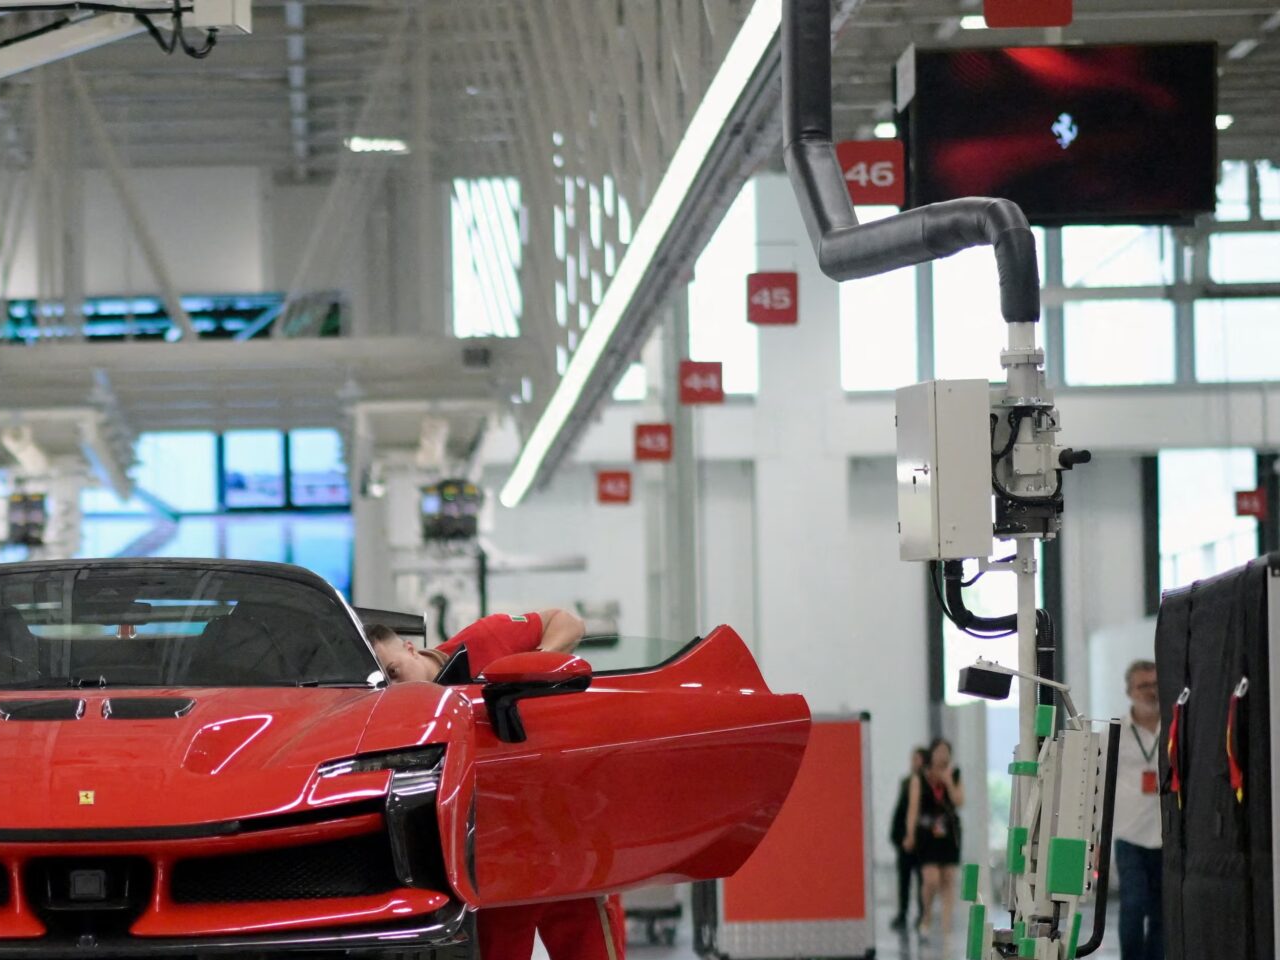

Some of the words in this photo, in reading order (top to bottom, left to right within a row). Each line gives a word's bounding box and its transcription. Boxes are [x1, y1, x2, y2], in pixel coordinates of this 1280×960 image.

[845, 161, 895, 188] 46
[751, 287, 791, 310] 45
[683, 372, 718, 392] 44
